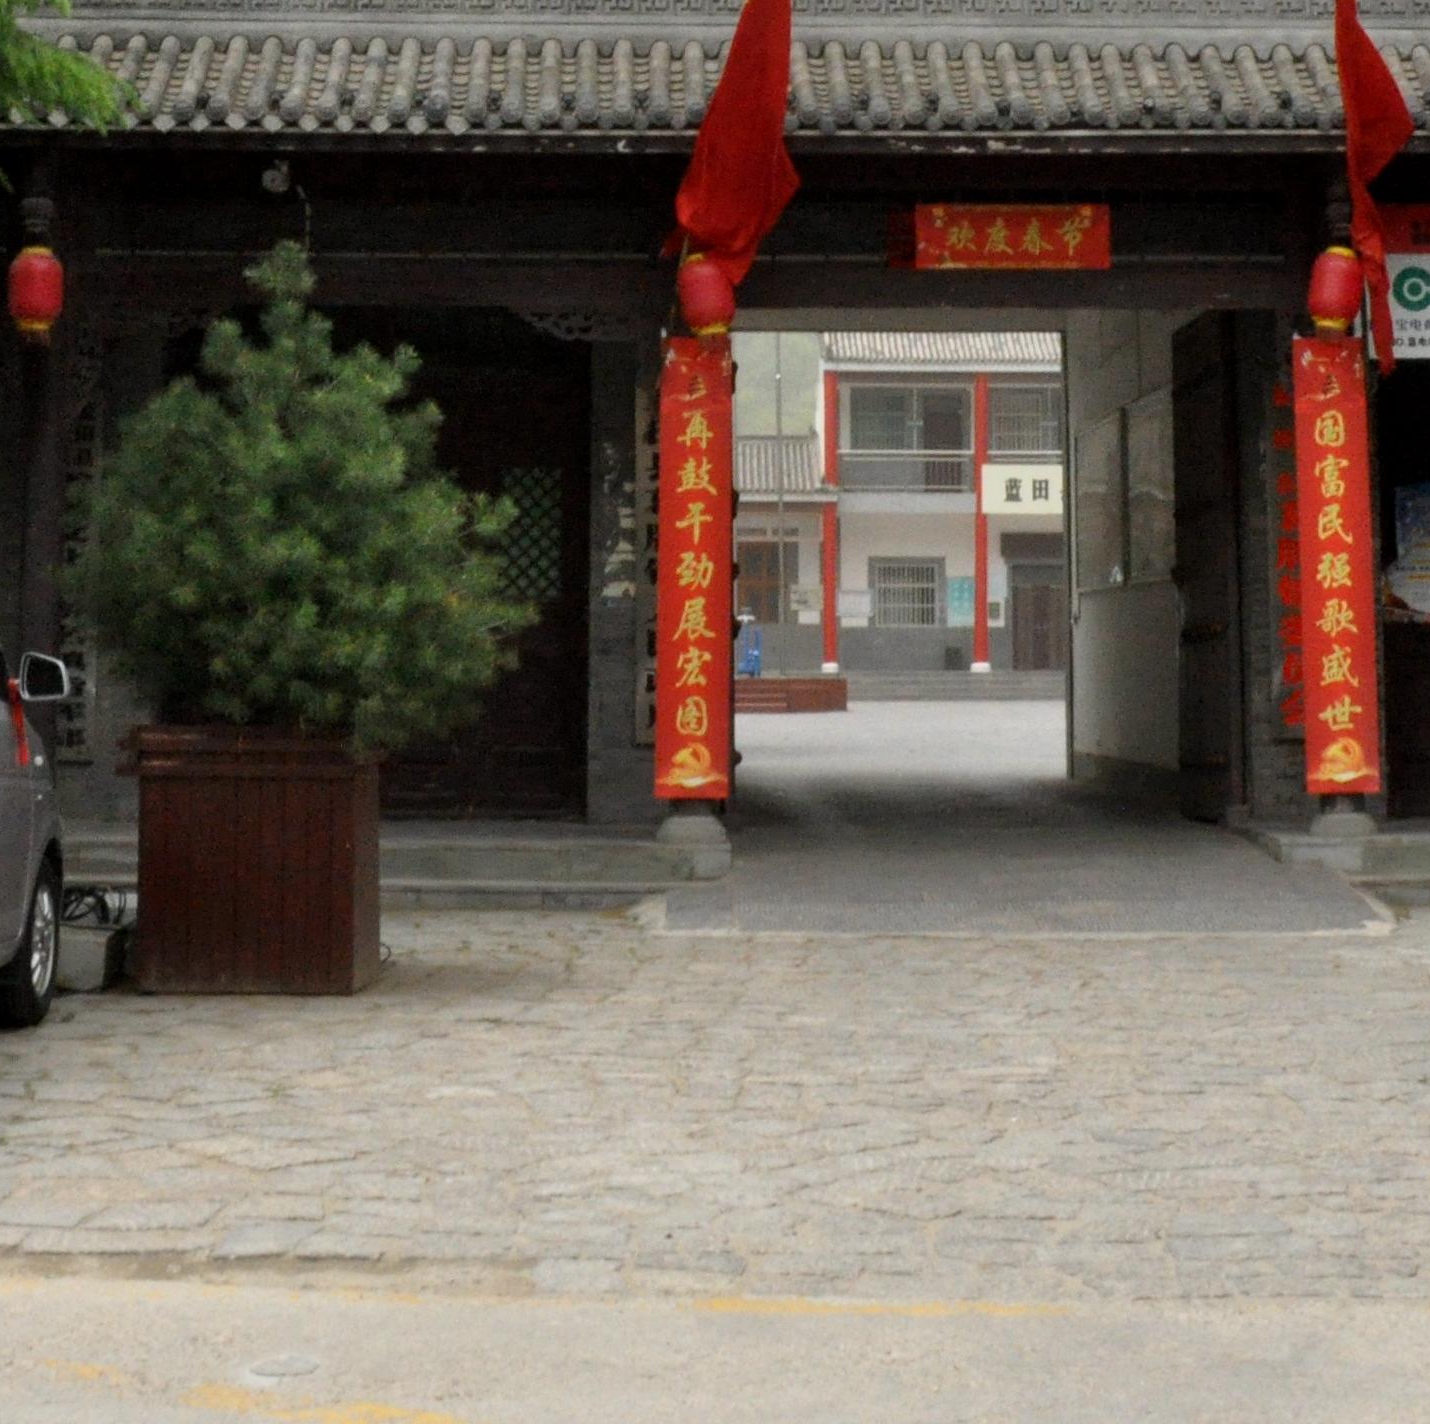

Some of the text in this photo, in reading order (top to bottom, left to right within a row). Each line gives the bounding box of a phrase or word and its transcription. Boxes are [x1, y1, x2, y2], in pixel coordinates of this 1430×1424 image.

[945, 217, 1084, 257] 欢度春节
[671, 410, 719, 739] 再鼓干劲展宏图
[1004, 478, 1062, 503] 蓝田
[1313, 409, 1364, 733] 国富民强歌盛世
